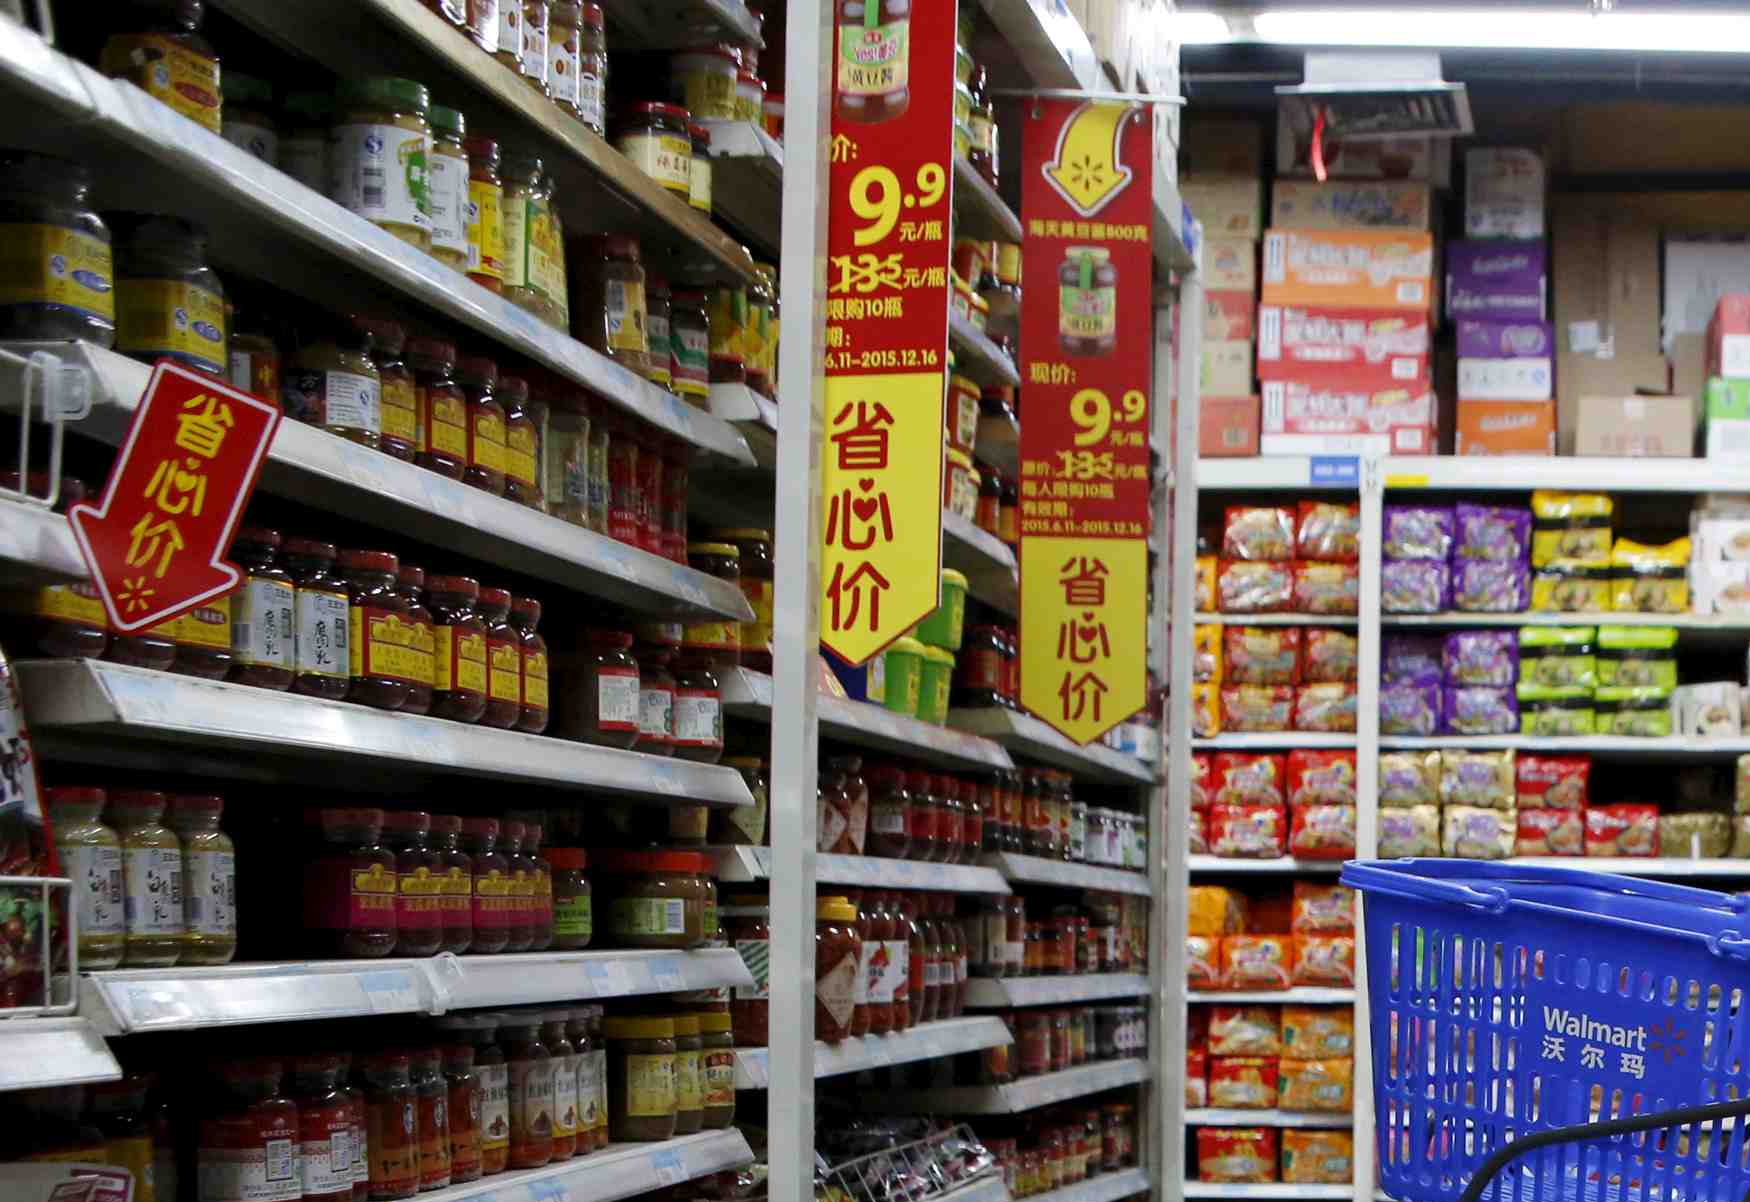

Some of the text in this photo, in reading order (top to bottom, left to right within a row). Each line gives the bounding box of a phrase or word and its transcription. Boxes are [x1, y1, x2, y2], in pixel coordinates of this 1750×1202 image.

[849, 162, 945, 246] 9.9
[1070, 388, 1146, 446] 9.9
[124, 393, 233, 578] 省心价
[825, 401, 895, 631] 省心价
[1057, 556, 1110, 721] 省心价
[1542, 1034, 1646, 1079] 沃尔玛
[1543, 1006, 1647, 1052] Walmart
